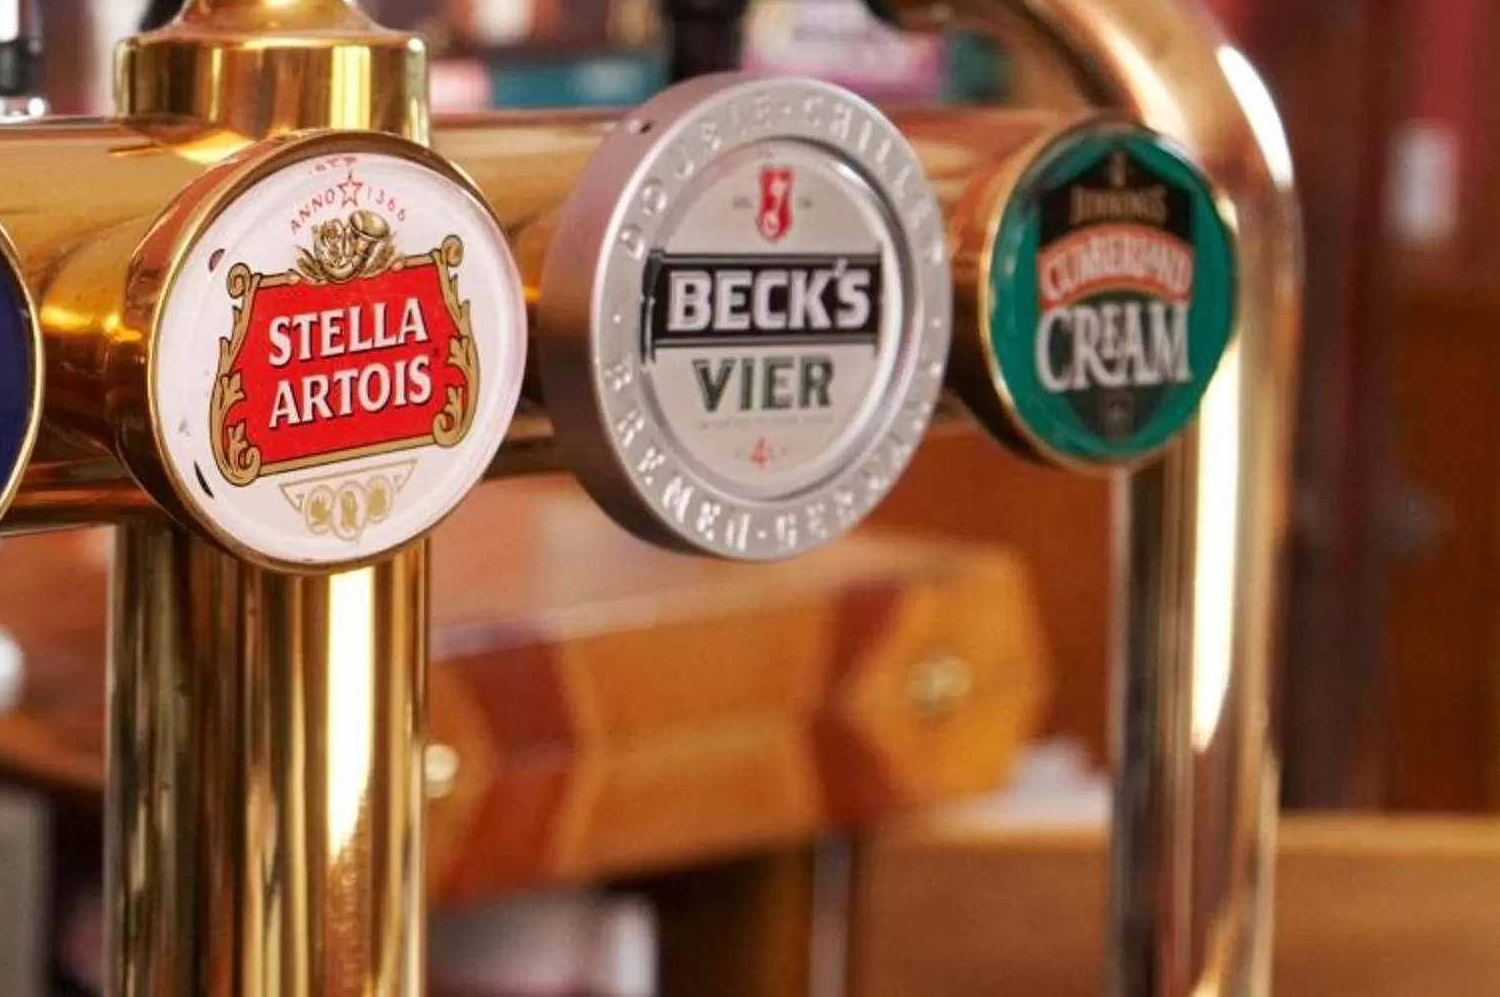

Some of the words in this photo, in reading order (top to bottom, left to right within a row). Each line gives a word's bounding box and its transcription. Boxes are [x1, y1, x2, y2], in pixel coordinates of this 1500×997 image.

[290, 187, 336, 234] ANNO
[268, 297, 429, 367] STELLA
[667, 259, 872, 333] BECK'S
[1034, 300, 1193, 392] CREAM
[267, 355, 433, 429] ARTOIS
[691, 355, 835, 413] VIER
